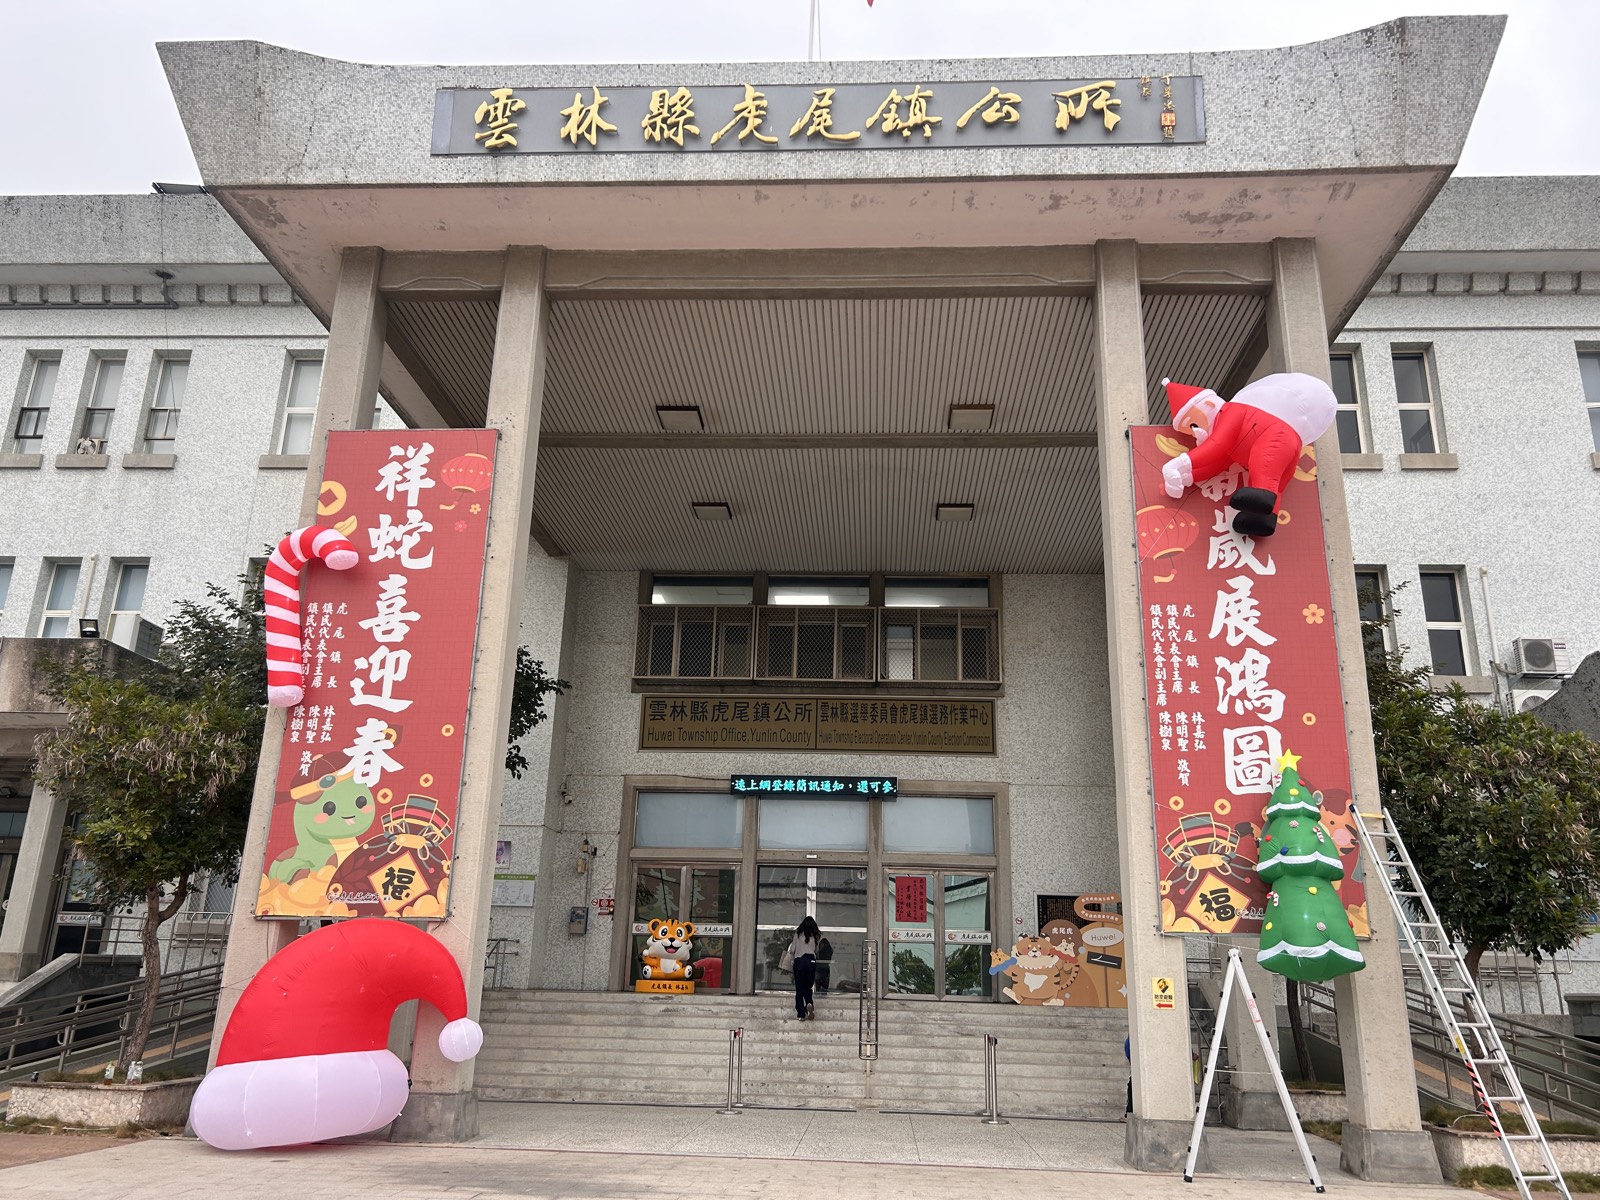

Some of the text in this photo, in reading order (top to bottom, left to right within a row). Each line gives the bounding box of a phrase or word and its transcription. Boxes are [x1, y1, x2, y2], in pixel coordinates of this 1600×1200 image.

[474, 79, 1122, 149] 雲林縣虎尾鎮公所
[337, 442, 436, 788] 祥蛇喜迎春
[305, 602, 334, 744] 鎮民代表會主席 陳明聖
[320, 603, 349, 743] 虎尾鎮長 林嘉弘
[1149, 604, 1173, 751] 鎮民代表會副主席 陳樹泉
[1166, 604, 1190, 752] 鎮民代表會主席 陳明聖
[1182, 604, 1207, 751] 虎尾鎮長 林嘉弘
[290, 704, 306, 743] 陳樹泉
[648, 700, 813, 723] 雲林縣虎尾鎮公所
[819, 701, 989, 726] 雲林縣選舉委員會虎尾鎮選務作業中心
[647, 727, 676, 742] Huwei
[677, 728, 718, 745] Township
[779, 728, 812, 747] County
[833, 730, 853, 746] Township
[299, 750, 313, 777] 敬賀
[1177, 758, 1191, 787] 敬賀
[381, 866, 416, 901] 福
[1199, 887, 1236, 922] 福
[1091, 933, 1117, 941] Huwei
